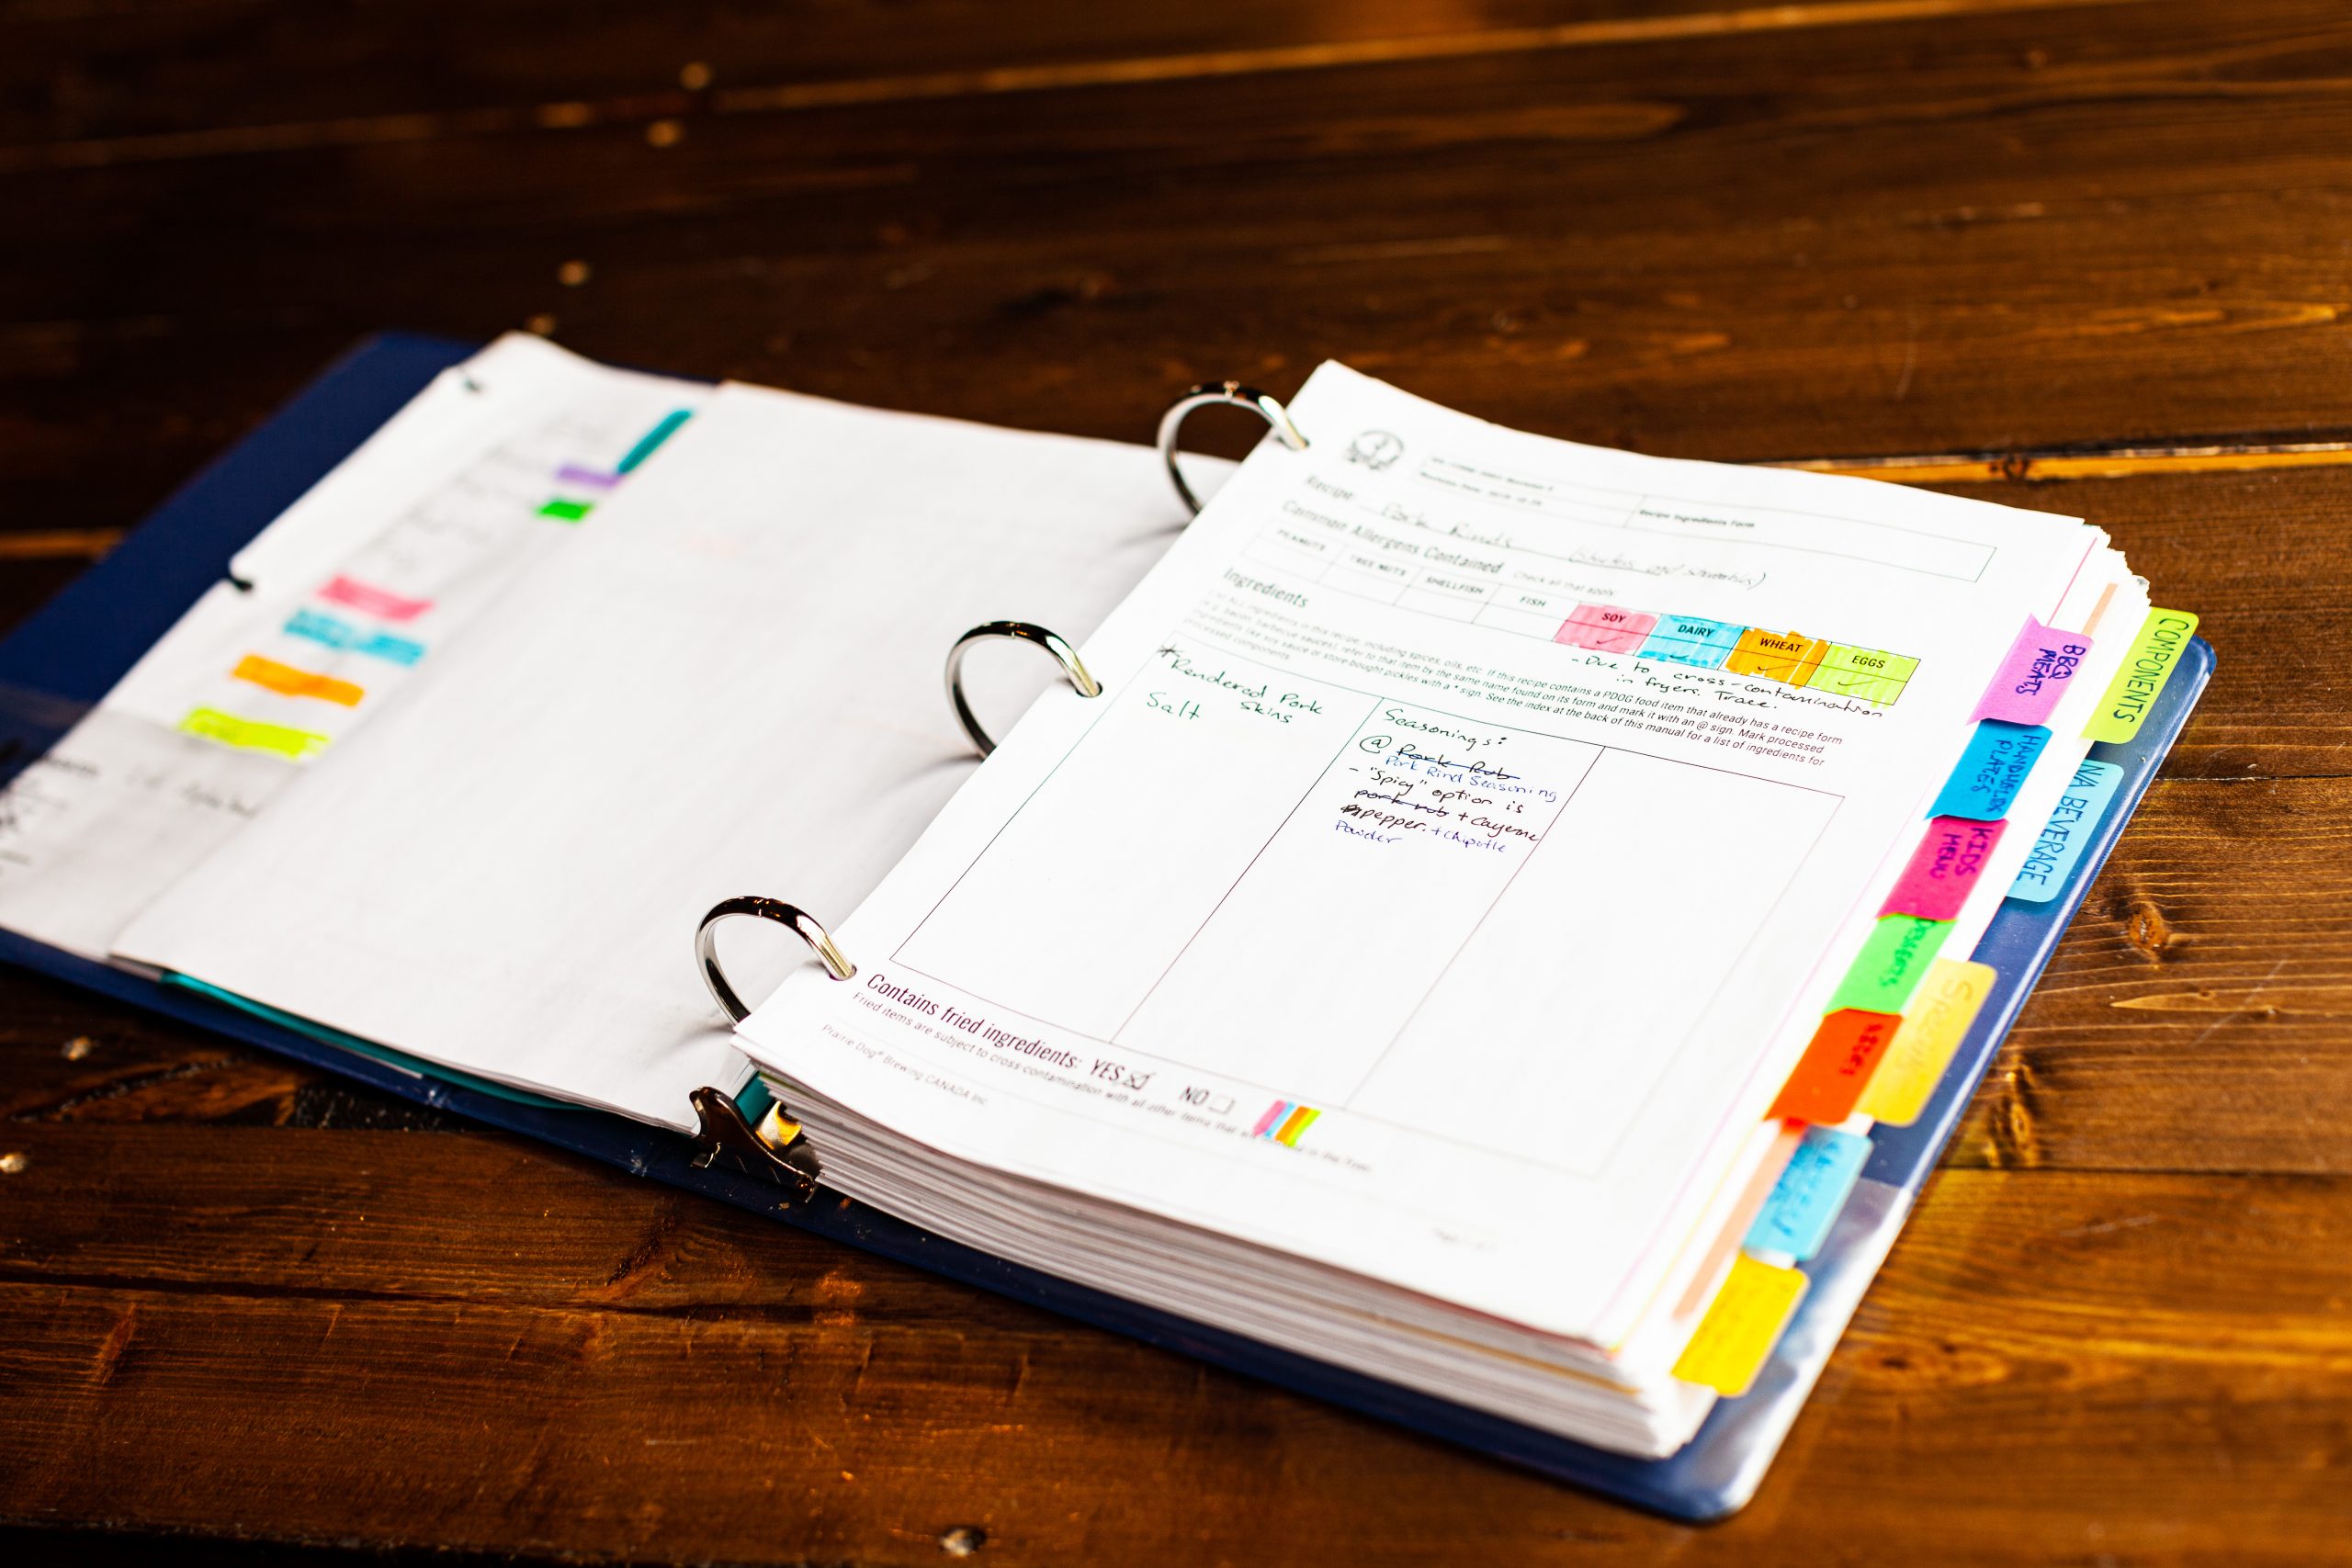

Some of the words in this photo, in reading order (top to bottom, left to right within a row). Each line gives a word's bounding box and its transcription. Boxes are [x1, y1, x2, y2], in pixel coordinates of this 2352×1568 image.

[1282, 500, 1348, 531] Common
[1351, 525, 1420, 555] Allergens
[1423, 546, 1505, 574] Contained
[1223, 567, 1309, 608] Ingredients
[1426, 576, 1486, 594] SHELLFISH
[1519, 595, 1547, 607] FISH
[1601, 612, 1627, 624] SOY
[1677, 624, 1715, 637] DAIRY
[1585, 655, 1619, 670] Due
[1633, 660, 1650, 673] to
[1759, 637, 1804, 653] WHEAT
[1851, 655, 1886, 670] EGGS
[2047, 643, 2087, 681] BBQ
[1616, 674, 1634, 684] in
[2015, 647, 2058, 697] MEATS
[2111, 616, 2189, 724] COMPONENTS
[1147, 692, 1203, 720] Salt
[1240, 701, 1294, 724] Skins
[1279, 693, 1323, 715] Pork
[1282, 641, 1309, 653] sauce
[1310, 649, 1321, 657] or
[1323, 653, 1384, 672] store-bought
[1384, 669, 1419, 683] pickles
[1421, 679, 1442, 688] with
[1486, 693, 1505, 704] See
[1507, 697, 1522, 707] the
[1524, 701, 1550, 713] index
[1553, 706, 1565, 715] at
[1566, 708, 1583, 717] the
[1584, 711, 1609, 723] back
[1611, 716, 1625, 725] of
[1624, 719, 1644, 729] this
[1645, 723, 1685, 738] manual
[1687, 730, 1702, 741] for
[1713, 736, 1731, 747] list
[1732, 740, 1747, 750] of
[1746, 741, 1806, 763] ingredients
[1809, 755, 1826, 766] for
[1365, 641, 1408, 658] including
[1487, 669, 1496, 677] If
[1497, 671, 1516, 682] this
[1517, 676, 1548, 689] recipe
[1549, 683, 1592, 696] contains
[1602, 691, 1634, 704] PDOG
[1634, 696, 1659, 707] food
[1660, 701, 1684, 713] item
[1686, 706, 1708, 717] that
[1709, 711, 1748, 727] already
[1749, 718, 1770, 729] has
[1781, 725, 1815, 739] recipe
[1817, 732, 1843, 746] form
[1366, 650, 1376, 660] to
[1378, 655, 1397, 666] that
[1399, 660, 1420, 672] item
[1422, 665, 1434, 675] by
[1436, 670, 1452, 679] the
[1453, 674, 1480, 685] same
[1482, 681, 1510, 693] name
[1511, 687, 1542, 699] found
[1542, 693, 1555, 702] on
[1556, 695, 1570, 705] its
[1572, 697, 1596, 708] form
[1598, 702, 1617, 713] and
[1619, 706, 1645, 717] mark
[1647, 711, 1656, 719] it
[1657, 713, 1679, 724] with
[1681, 718, 1695, 727] an
[1696, 721, 1709, 731] @
[1710, 724, 1735, 736] sign.
[1738, 728, 1766, 741] Mark
[1766, 734, 1825, 755] processed
[1383, 708, 1508, 751] Seasonings:
[1385, 755, 1419, 772] Pork
[1426, 765, 1463, 784] Rind
[1470, 774, 1558, 804] Seasoning
[1971, 739, 2014, 794] PLATES
[1985, 734, 2042, 814] HANDHELDS
[1431, 788, 1493, 806] option
[1506, 801, 1524, 814] is
[1335, 818, 1403, 845] Powder
[1953, 827, 1995, 877] KIDS
[2016, 795, 2089, 886] BEVERAGE
[1929, 832, 1962, 880] MENU
[821, 1022, 855, 1048] Prairie
[882, 1054, 925, 1082] Brewing
[924, 1074, 970, 1100] CANADA
[853, 991, 881, 1013] Fried
[881, 1006, 914, 1026] items
[914, 1021, 933, 1035] are
[933, 1030, 976, 1054] subject
[976, 1046, 989, 1058] to
[989, 1052, 1102, 1095] cross-contamination
[1105, 1091, 1129, 1103] with
[1131, 1098, 1145, 1109] all
[1147, 1101, 1176, 1117] other
[866, 972, 940, 1017] Contains
[940, 1006, 986, 1035] fried
[981, 1022, 1083, 1069] ingredients:
[1089, 1057, 1125, 1083] YES
[1178, 1085, 1211, 1107] NO
